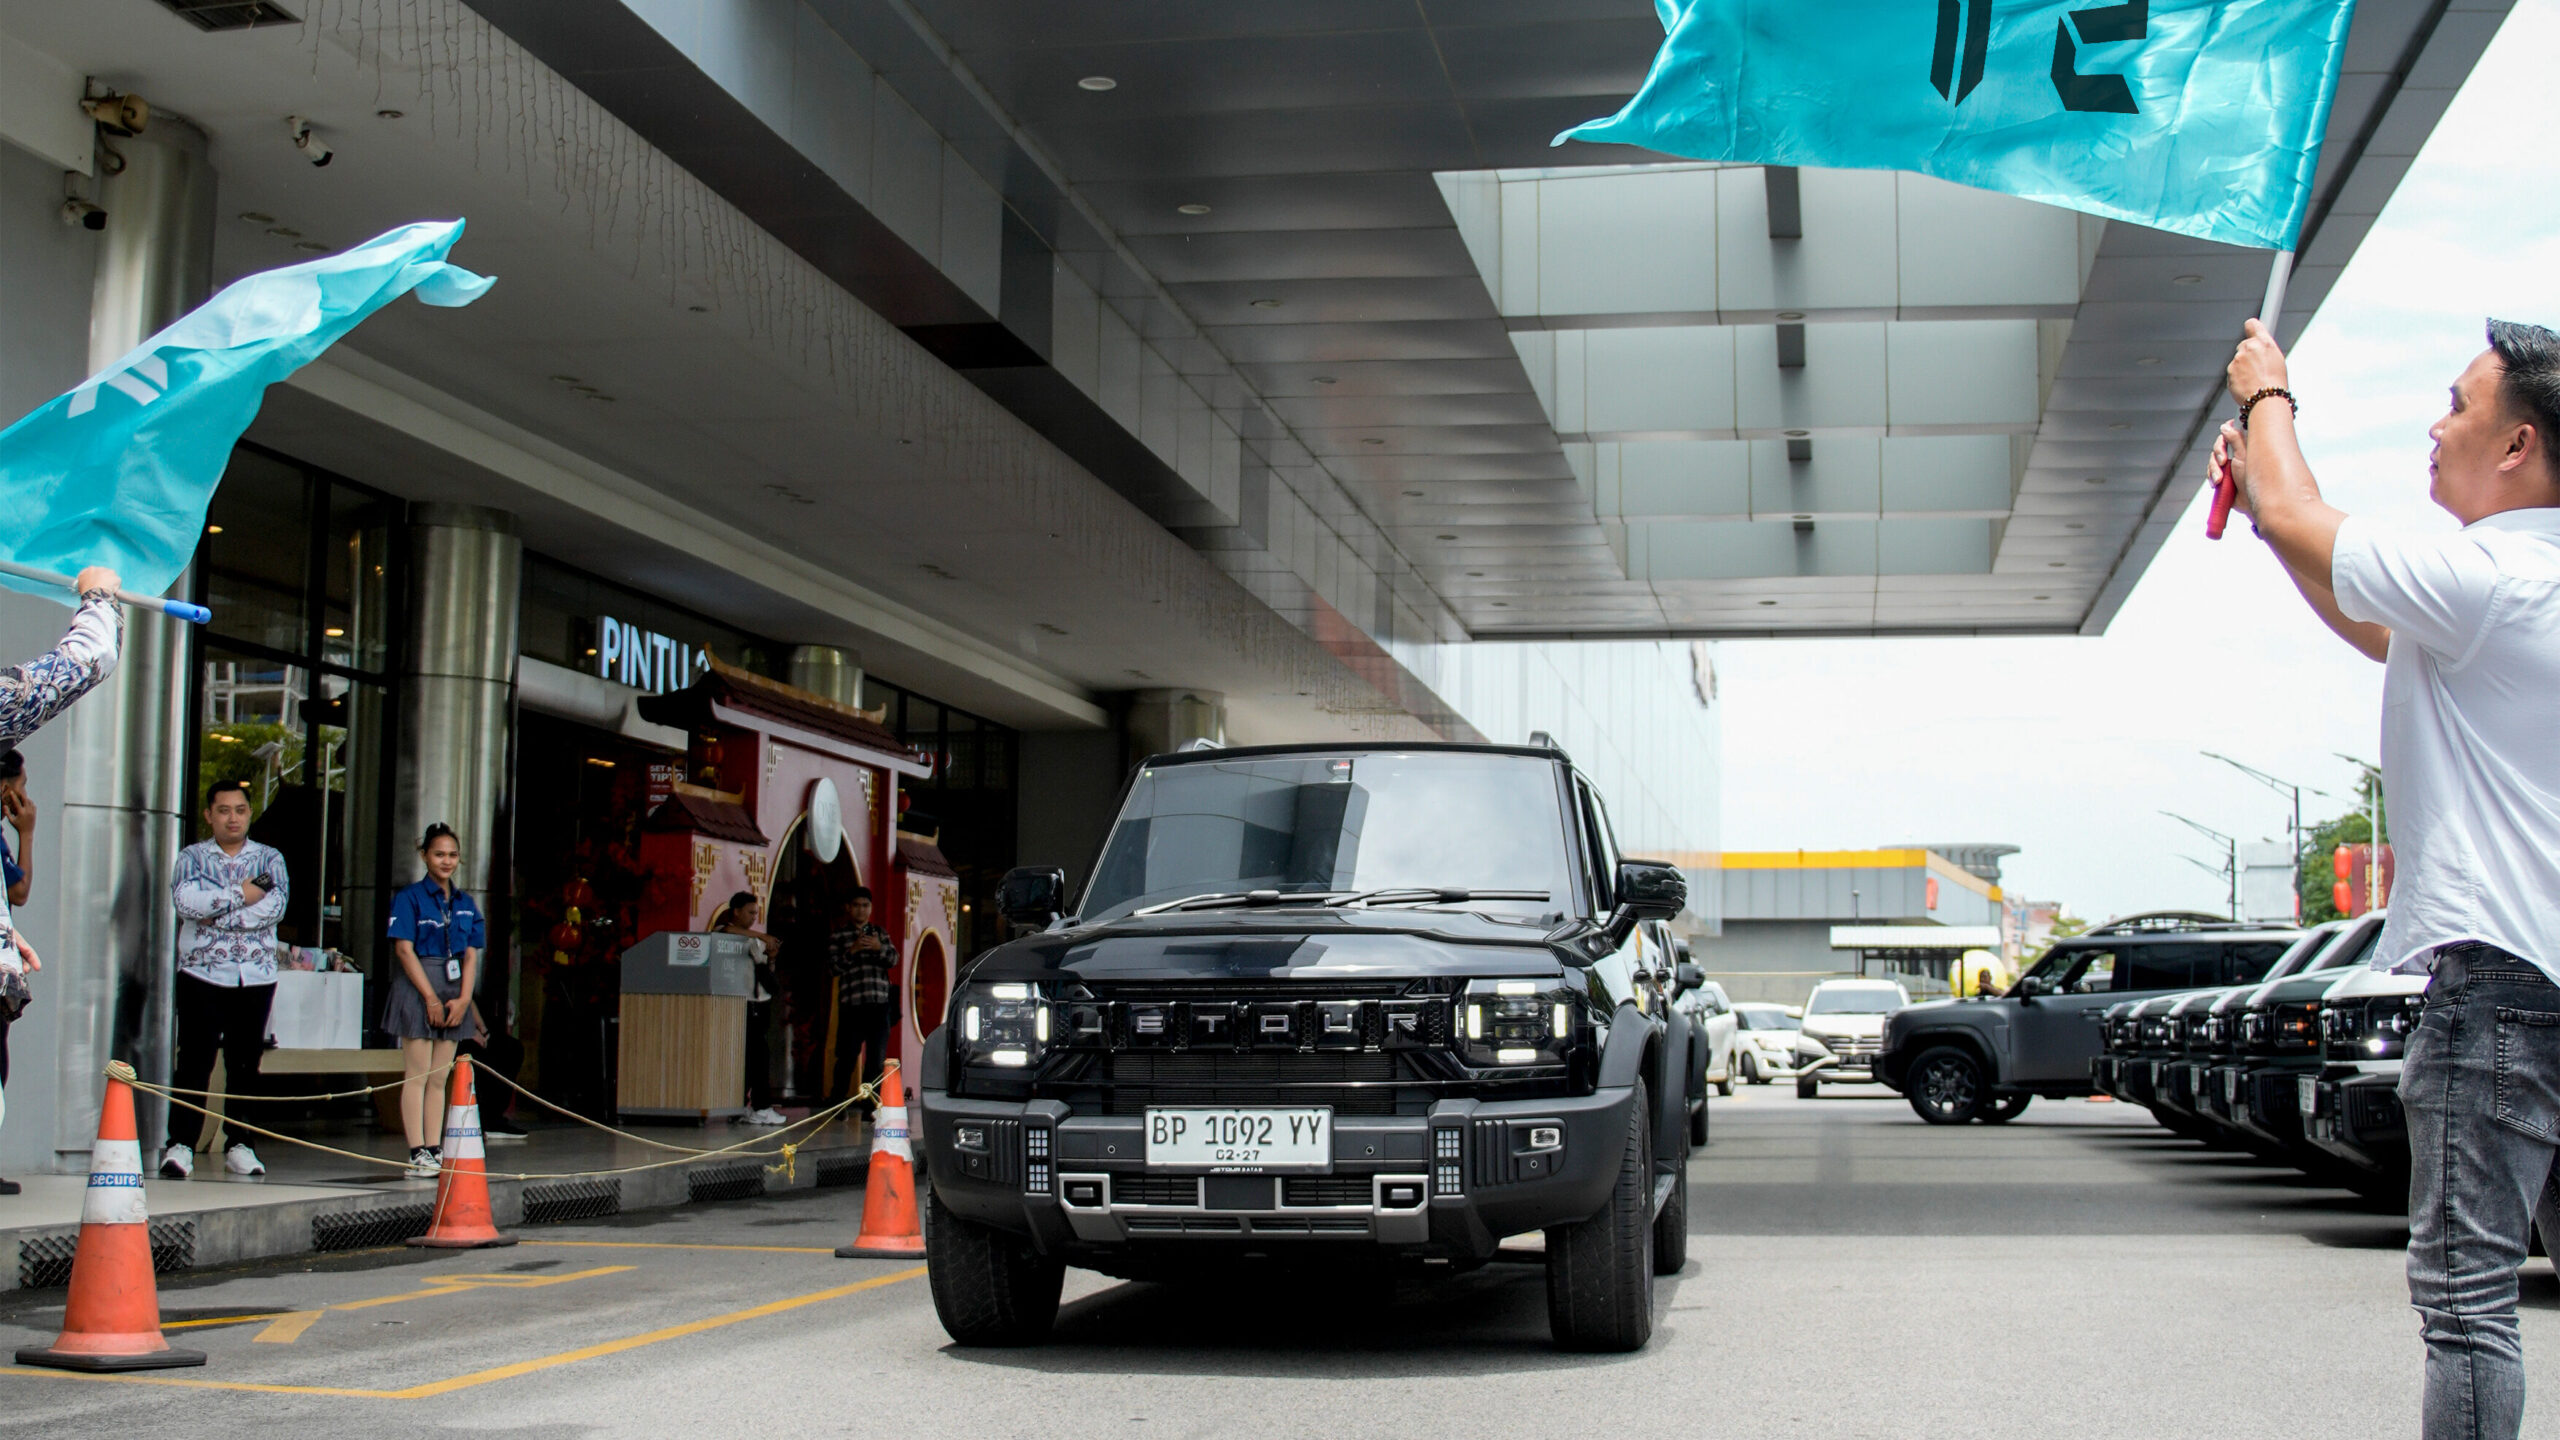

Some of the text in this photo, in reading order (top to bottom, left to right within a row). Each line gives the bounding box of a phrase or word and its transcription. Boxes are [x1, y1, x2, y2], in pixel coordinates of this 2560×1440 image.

[600, 615, 690, 696] PINTU
[1079, 1013, 1418, 1034] JETOUR
[1152, 1115, 1323, 1145] BP 1092 YY
[92, 1174, 137, 1186] secure
